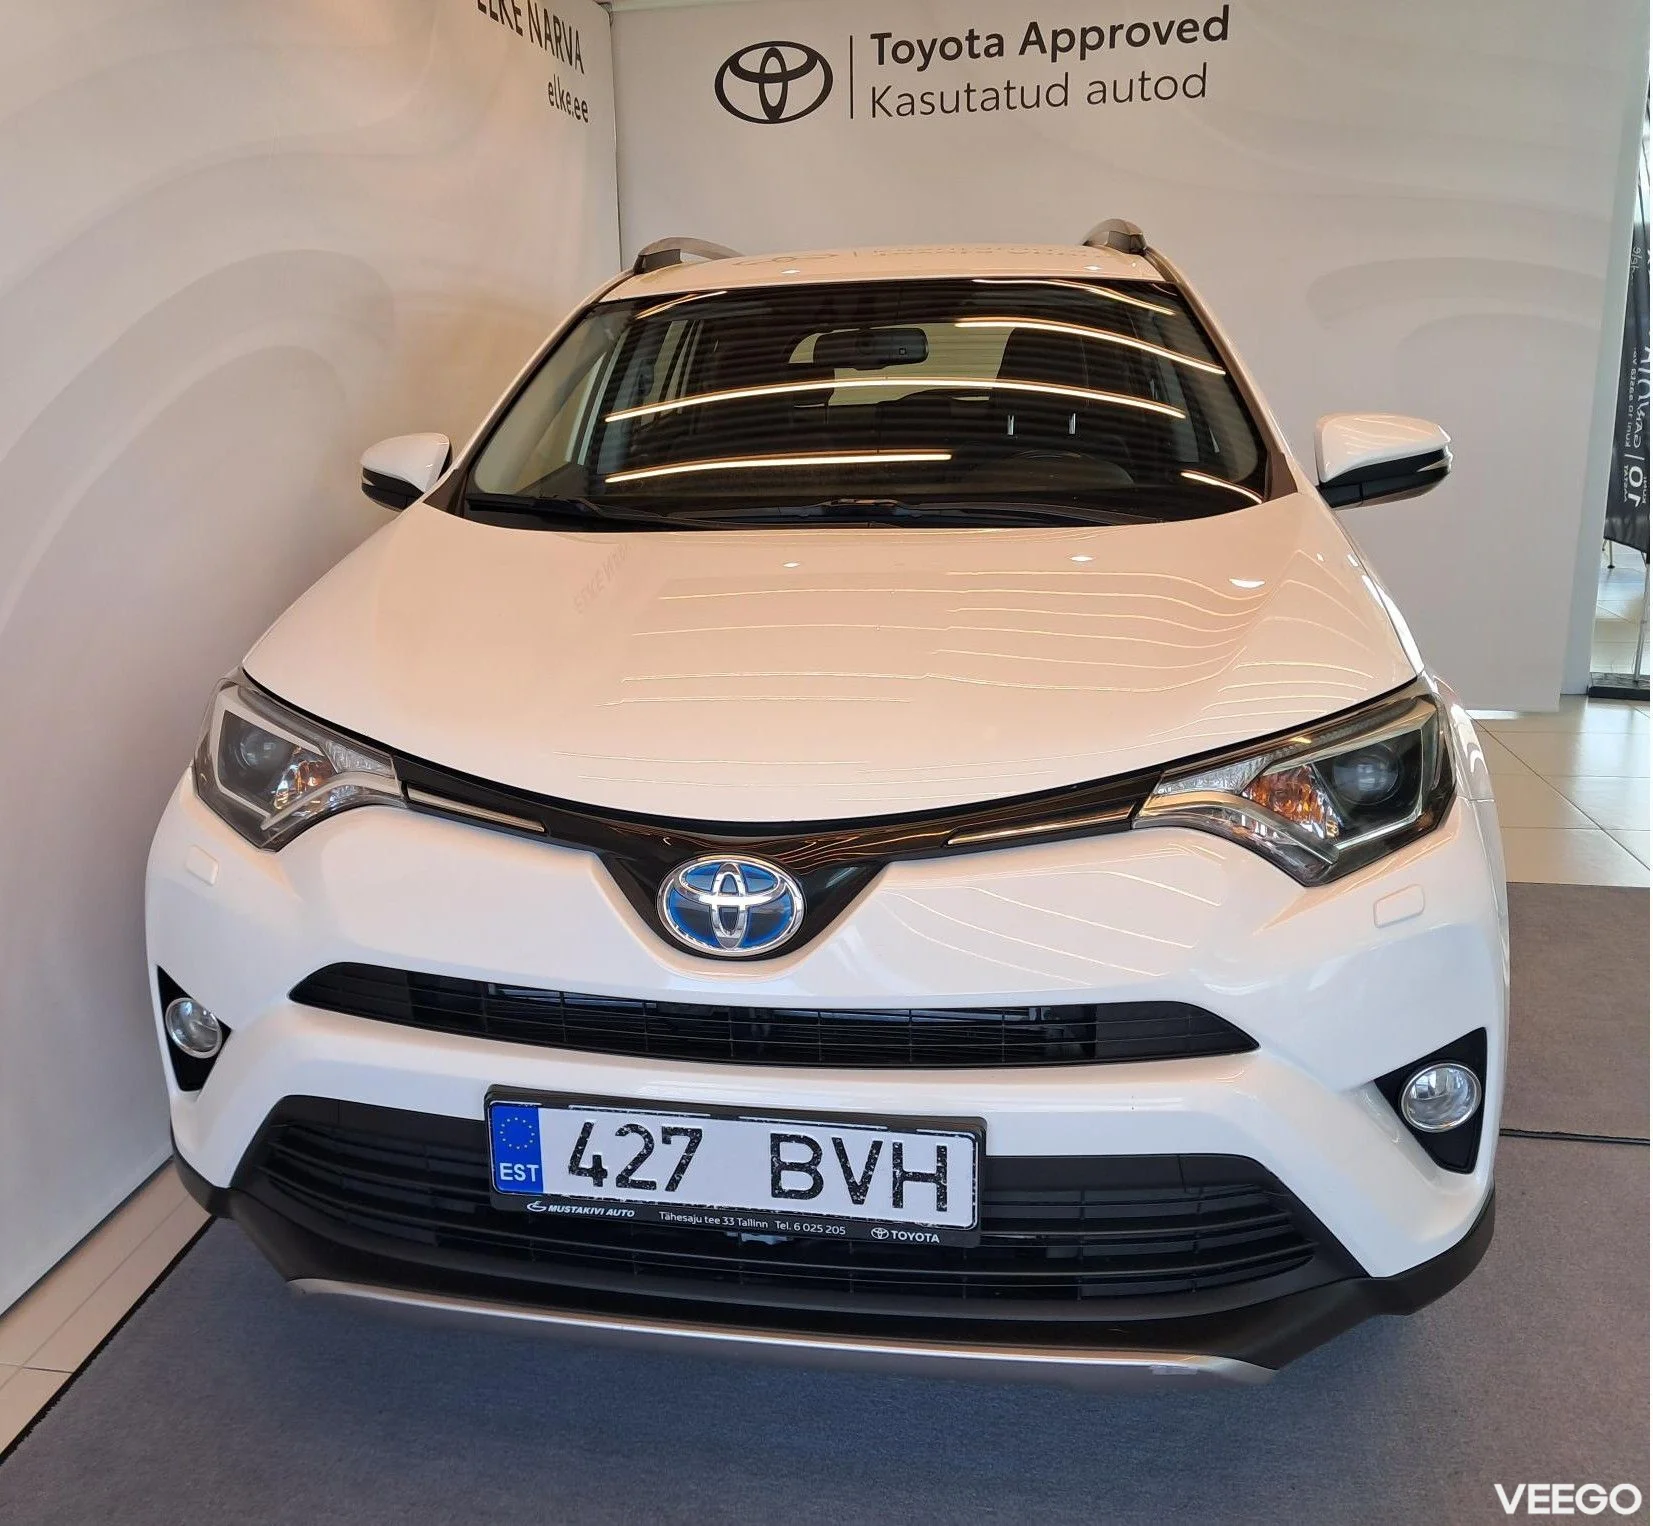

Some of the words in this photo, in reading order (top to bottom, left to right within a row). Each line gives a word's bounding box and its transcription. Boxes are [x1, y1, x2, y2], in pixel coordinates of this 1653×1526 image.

[477, 0, 523, 37] LKE
[526, 0, 585, 75] NARVA
[870, 28, 1005, 72] Toyota
[1018, 4, 1230, 63] Approved
[547, 73, 589, 123] elke.ee
[870, 71, 1069, 118] Kasutatud
[1086, 61, 1207, 105] autod
[499, 1162, 540, 1182] EST
[568, 1121, 703, 1192] 427
[770, 1132, 948, 1212] BVH
[548, 1204, 604, 1216] MUSTAKIVI
[606, 1208, 635, 1218] AUTO
[659, 1211, 702, 1225] Tähesaju
[704, 1216, 721, 1225] tee
[722, 1216, 735, 1226] 33
[736, 1217, 769, 1229] Tallinn
[774, 1220, 792, 1231] Tel.
[793, 1222, 800, 1232] 6
[802, 1223, 824, 1234] 025
[825, 1225, 846, 1235] 205
[891, 1230, 940, 1244] TOYOTA
